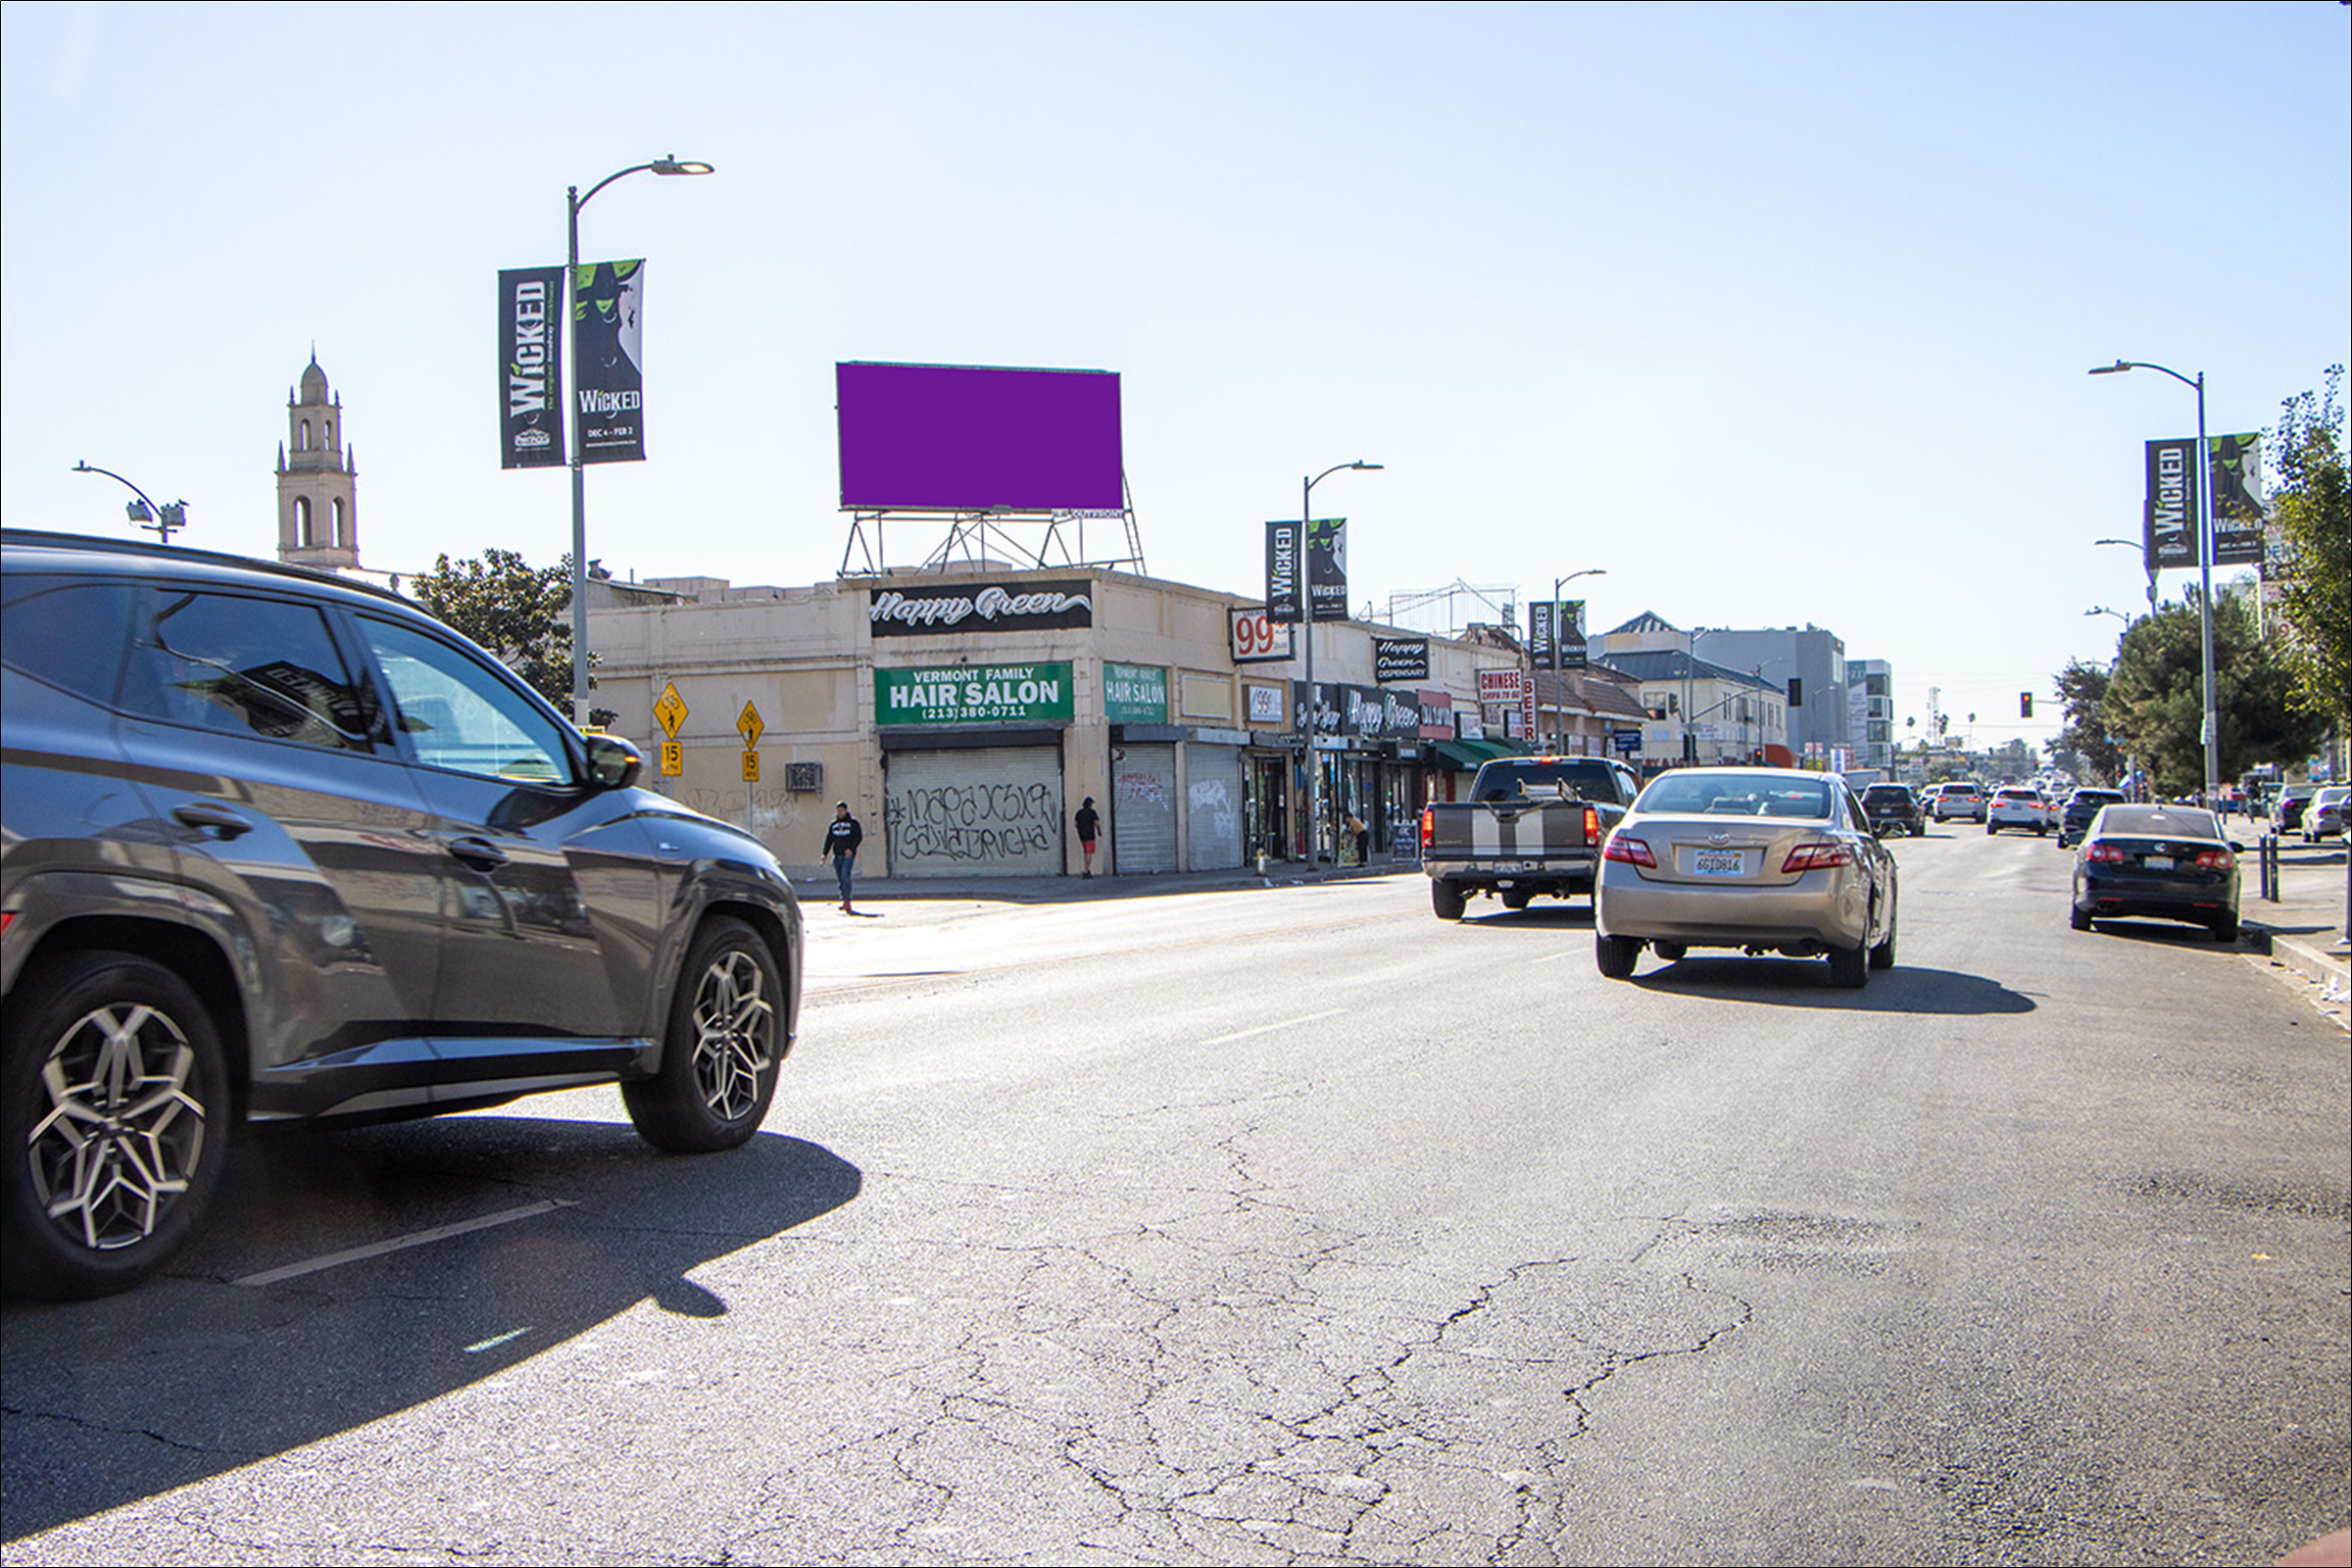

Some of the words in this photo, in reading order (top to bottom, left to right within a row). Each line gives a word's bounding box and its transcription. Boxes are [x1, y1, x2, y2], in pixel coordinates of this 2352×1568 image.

[868, 591, 974, 627] Happy
[975, 586, 1092, 621] Green
[1379, 641, 1425, 656] Happy
[1377, 656, 1426, 668] Green
[913, 669, 979, 683] VERMONT
[985, 667, 1035, 681] FAMILY
[1481, 672, 1520, 690] CHINESE
[890, 683, 957, 709] HAIR
[964, 680, 1059, 706] SALON
[1105, 680, 1132, 703] HAIR
[1133, 683, 1165, 705] SALON
[1523, 680, 1535, 740] BEER
[665, 745, 679, 761] 15
[746, 755, 757, 769] 15
